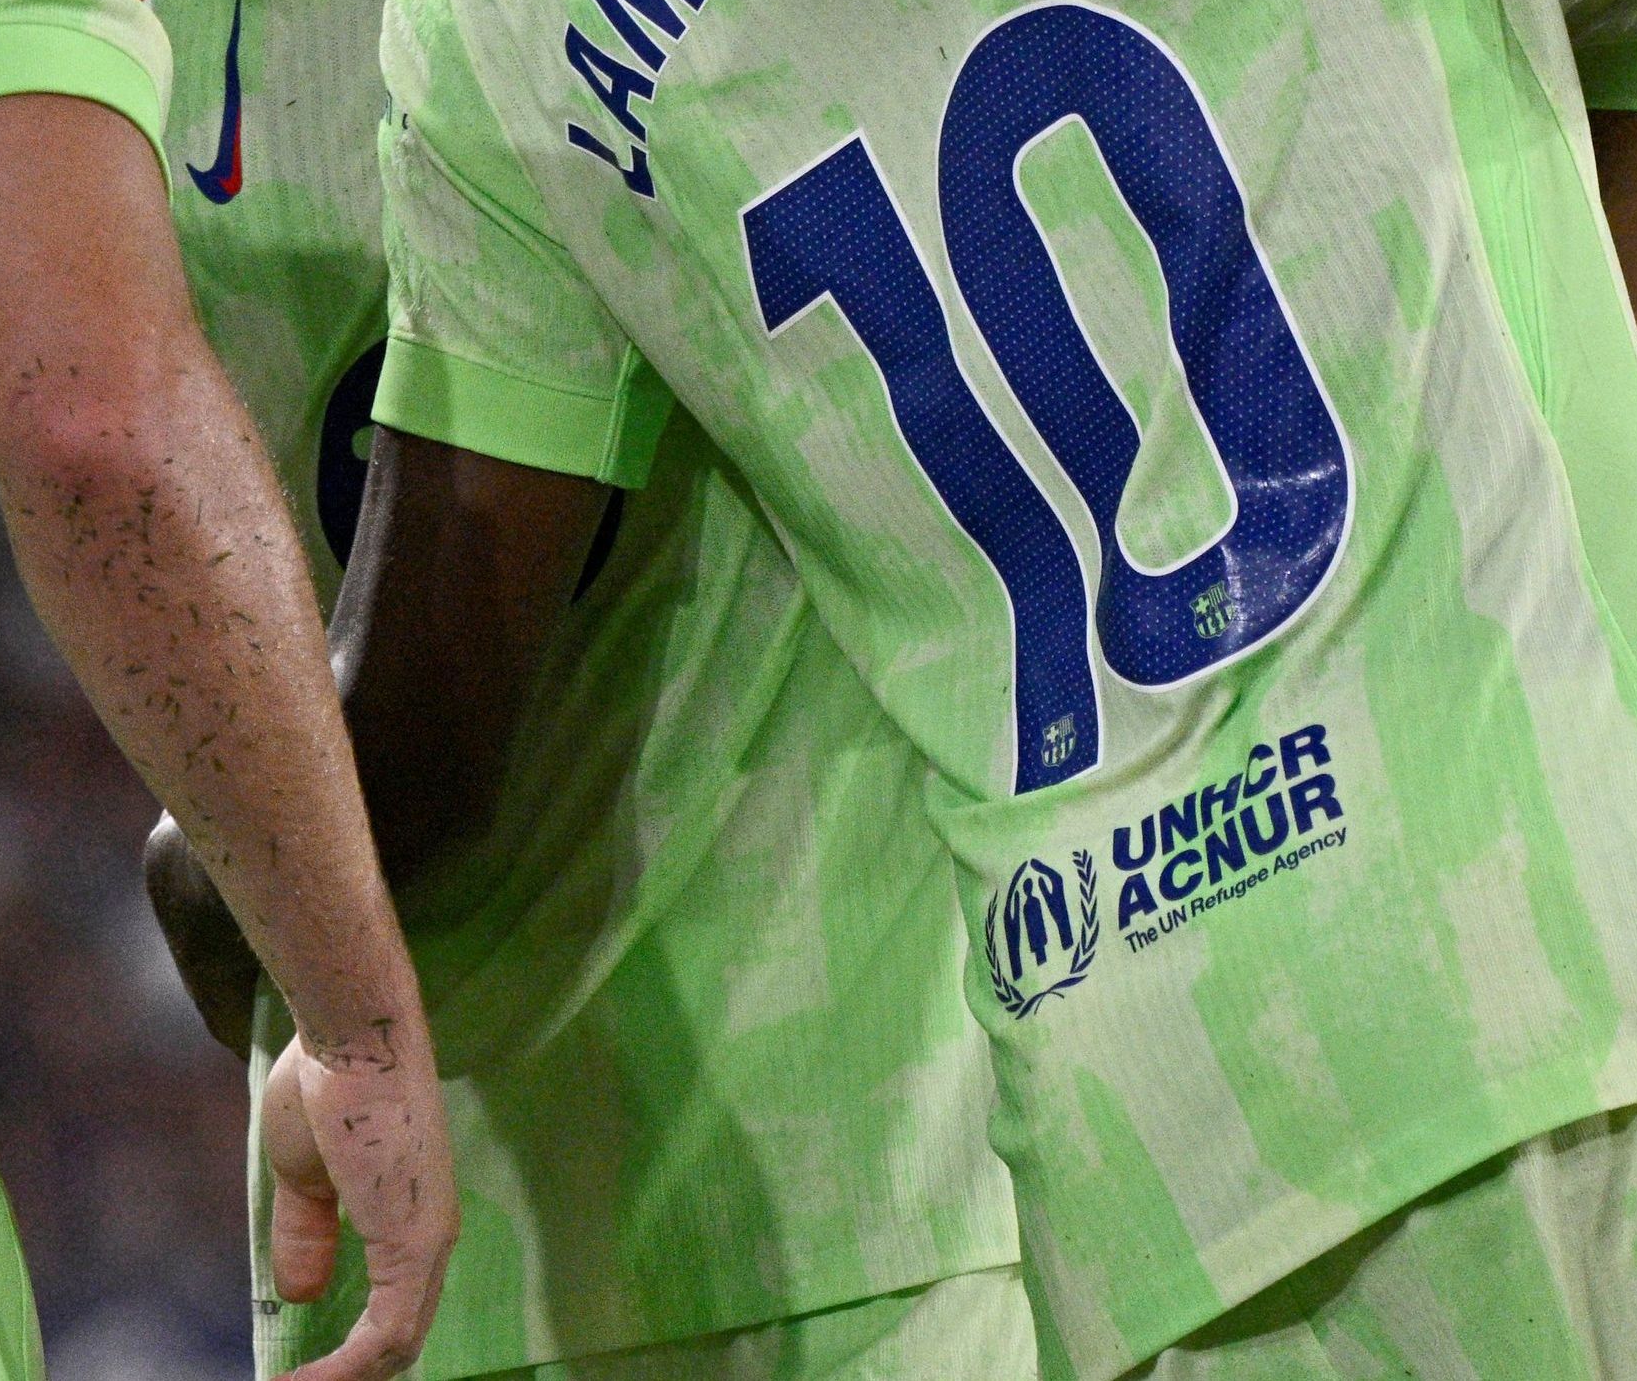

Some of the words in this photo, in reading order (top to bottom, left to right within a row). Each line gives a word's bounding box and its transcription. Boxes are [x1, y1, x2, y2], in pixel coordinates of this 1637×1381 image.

[1111, 723, 1333, 872] UNHCR
[1117, 772, 1345, 931] ACNUR
[1123, 925, 1159, 955] The
[1158, 904, 1188, 935] UN
[1189, 868, 1270, 918] Refugee
[1273, 826, 1348, 876] Agency
